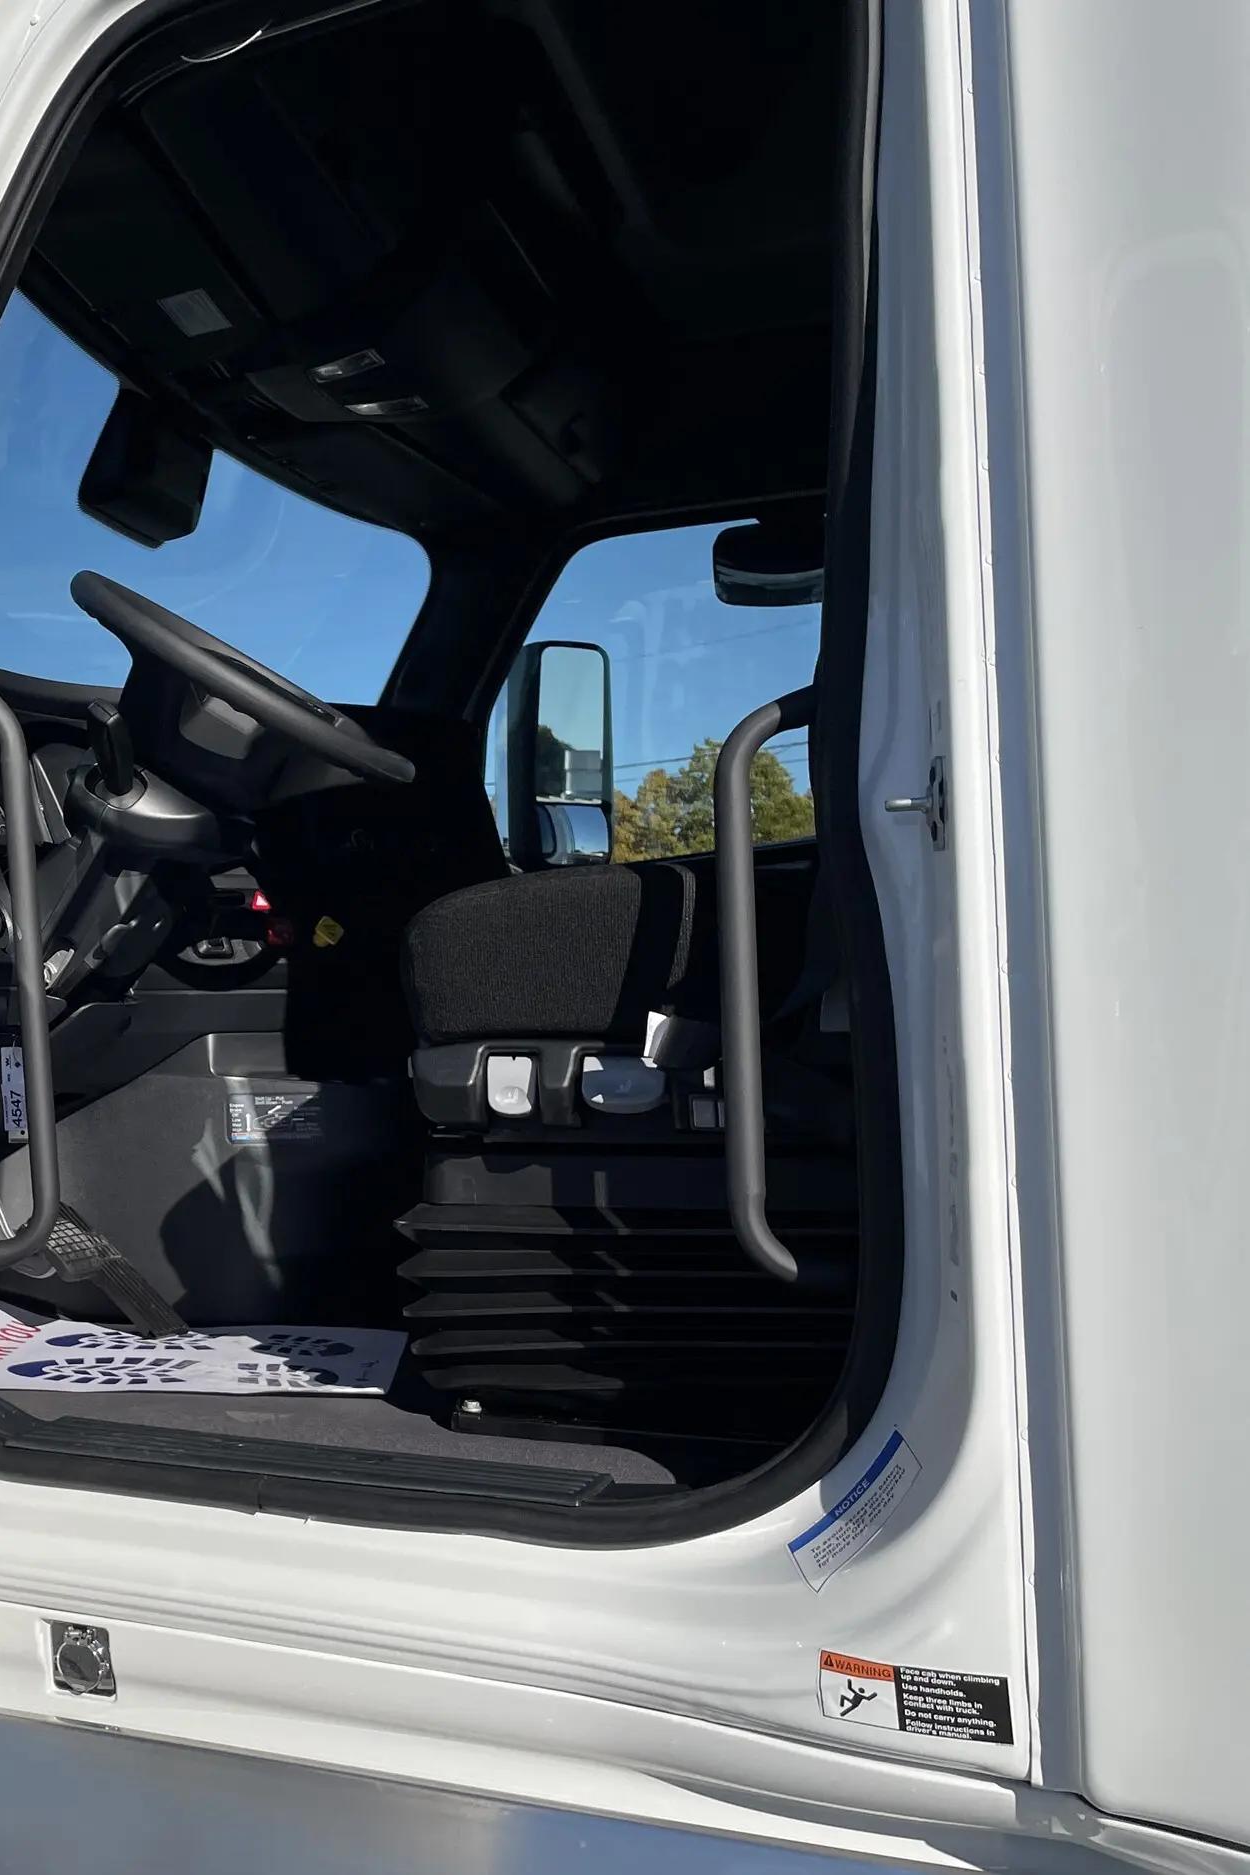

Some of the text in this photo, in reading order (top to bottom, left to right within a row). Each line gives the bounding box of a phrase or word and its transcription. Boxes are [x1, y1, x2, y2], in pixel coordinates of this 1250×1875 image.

[10, 1090, 22, 1128] 4547
[834, 1479, 870, 1516] NOTICE
[852, 1518, 865, 1534] OFF
[834, 1659, 891, 1678] WARNING
[900, 1667, 1000, 1686] Face cab when climbing
[902, 1682, 966, 1697] Use handholds.
[931, 1678, 956, 1686] down.
[903, 1693, 924, 1702] Keep
[926, 1696, 947, 1704] three
[949, 1699, 972, 1708] limbs
[903, 1700, 980, 1715] contact with truck.
[904, 1709, 996, 1728] Do not carry anything.
[906, 1719, 932, 1728] Follow
[935, 1723, 984, 1736] instructions
[906, 1726, 972, 1739] driver's manual.
